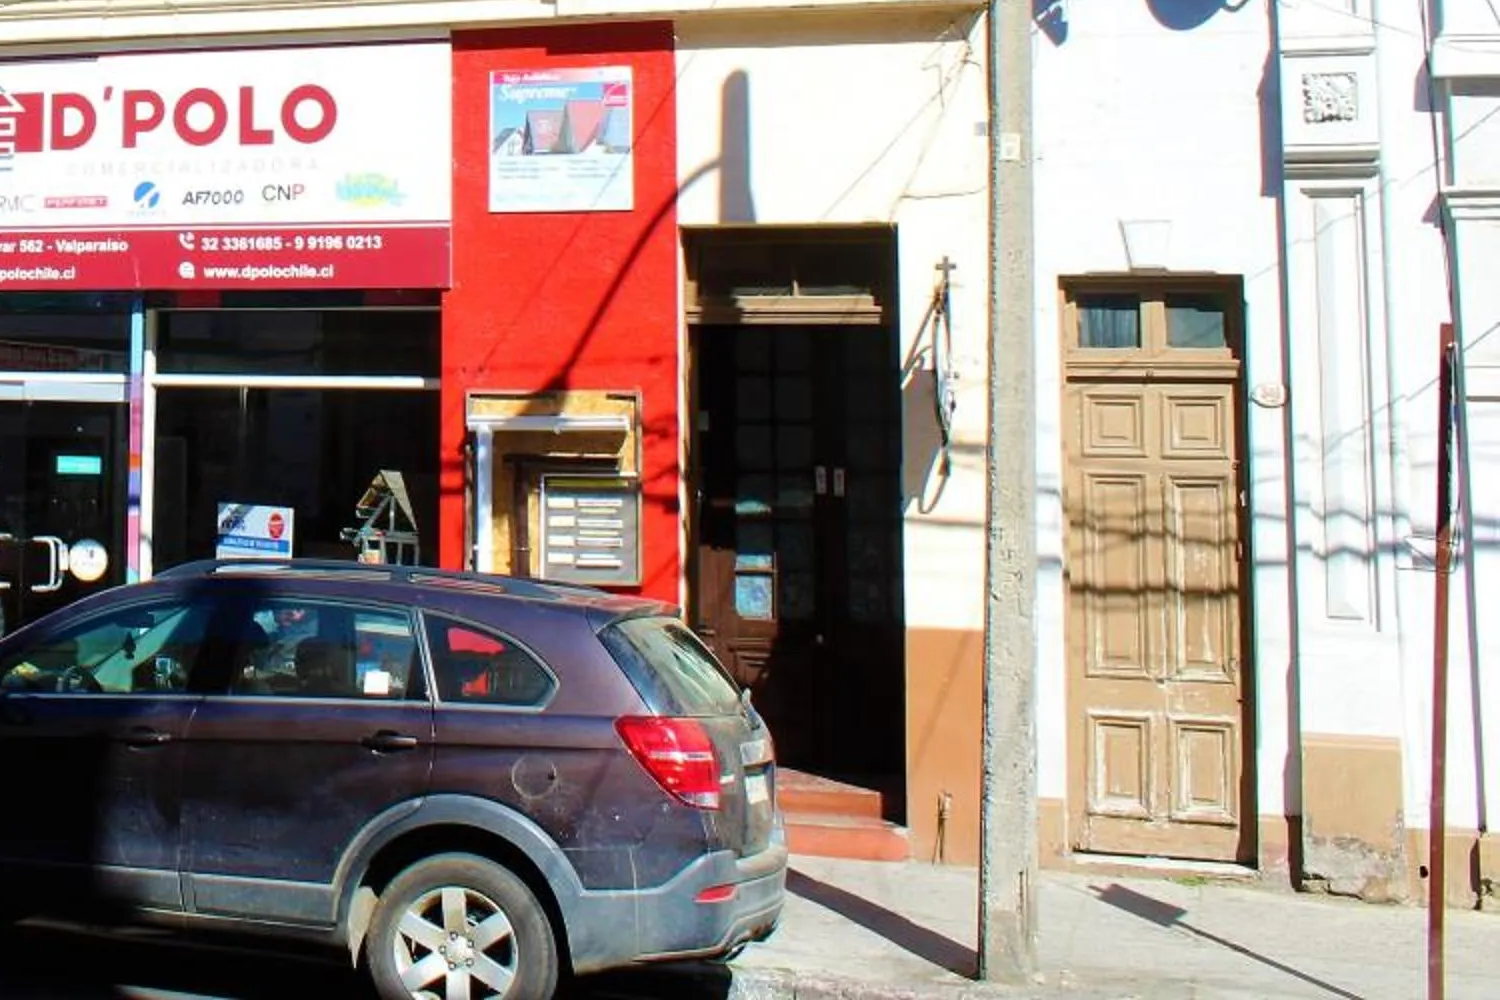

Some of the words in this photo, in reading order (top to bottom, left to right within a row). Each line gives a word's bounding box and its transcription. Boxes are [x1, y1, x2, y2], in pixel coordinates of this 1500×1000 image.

[66, 156, 320, 177] COMERCIALIZADORA
[182, 189, 244, 206] AF7000
[261, 184, 305, 202] CNP
[201, 237, 218, 251] 32
[346, 235, 382, 249] 0213
[203, 264, 335, 281] www.dpolochile.cl
